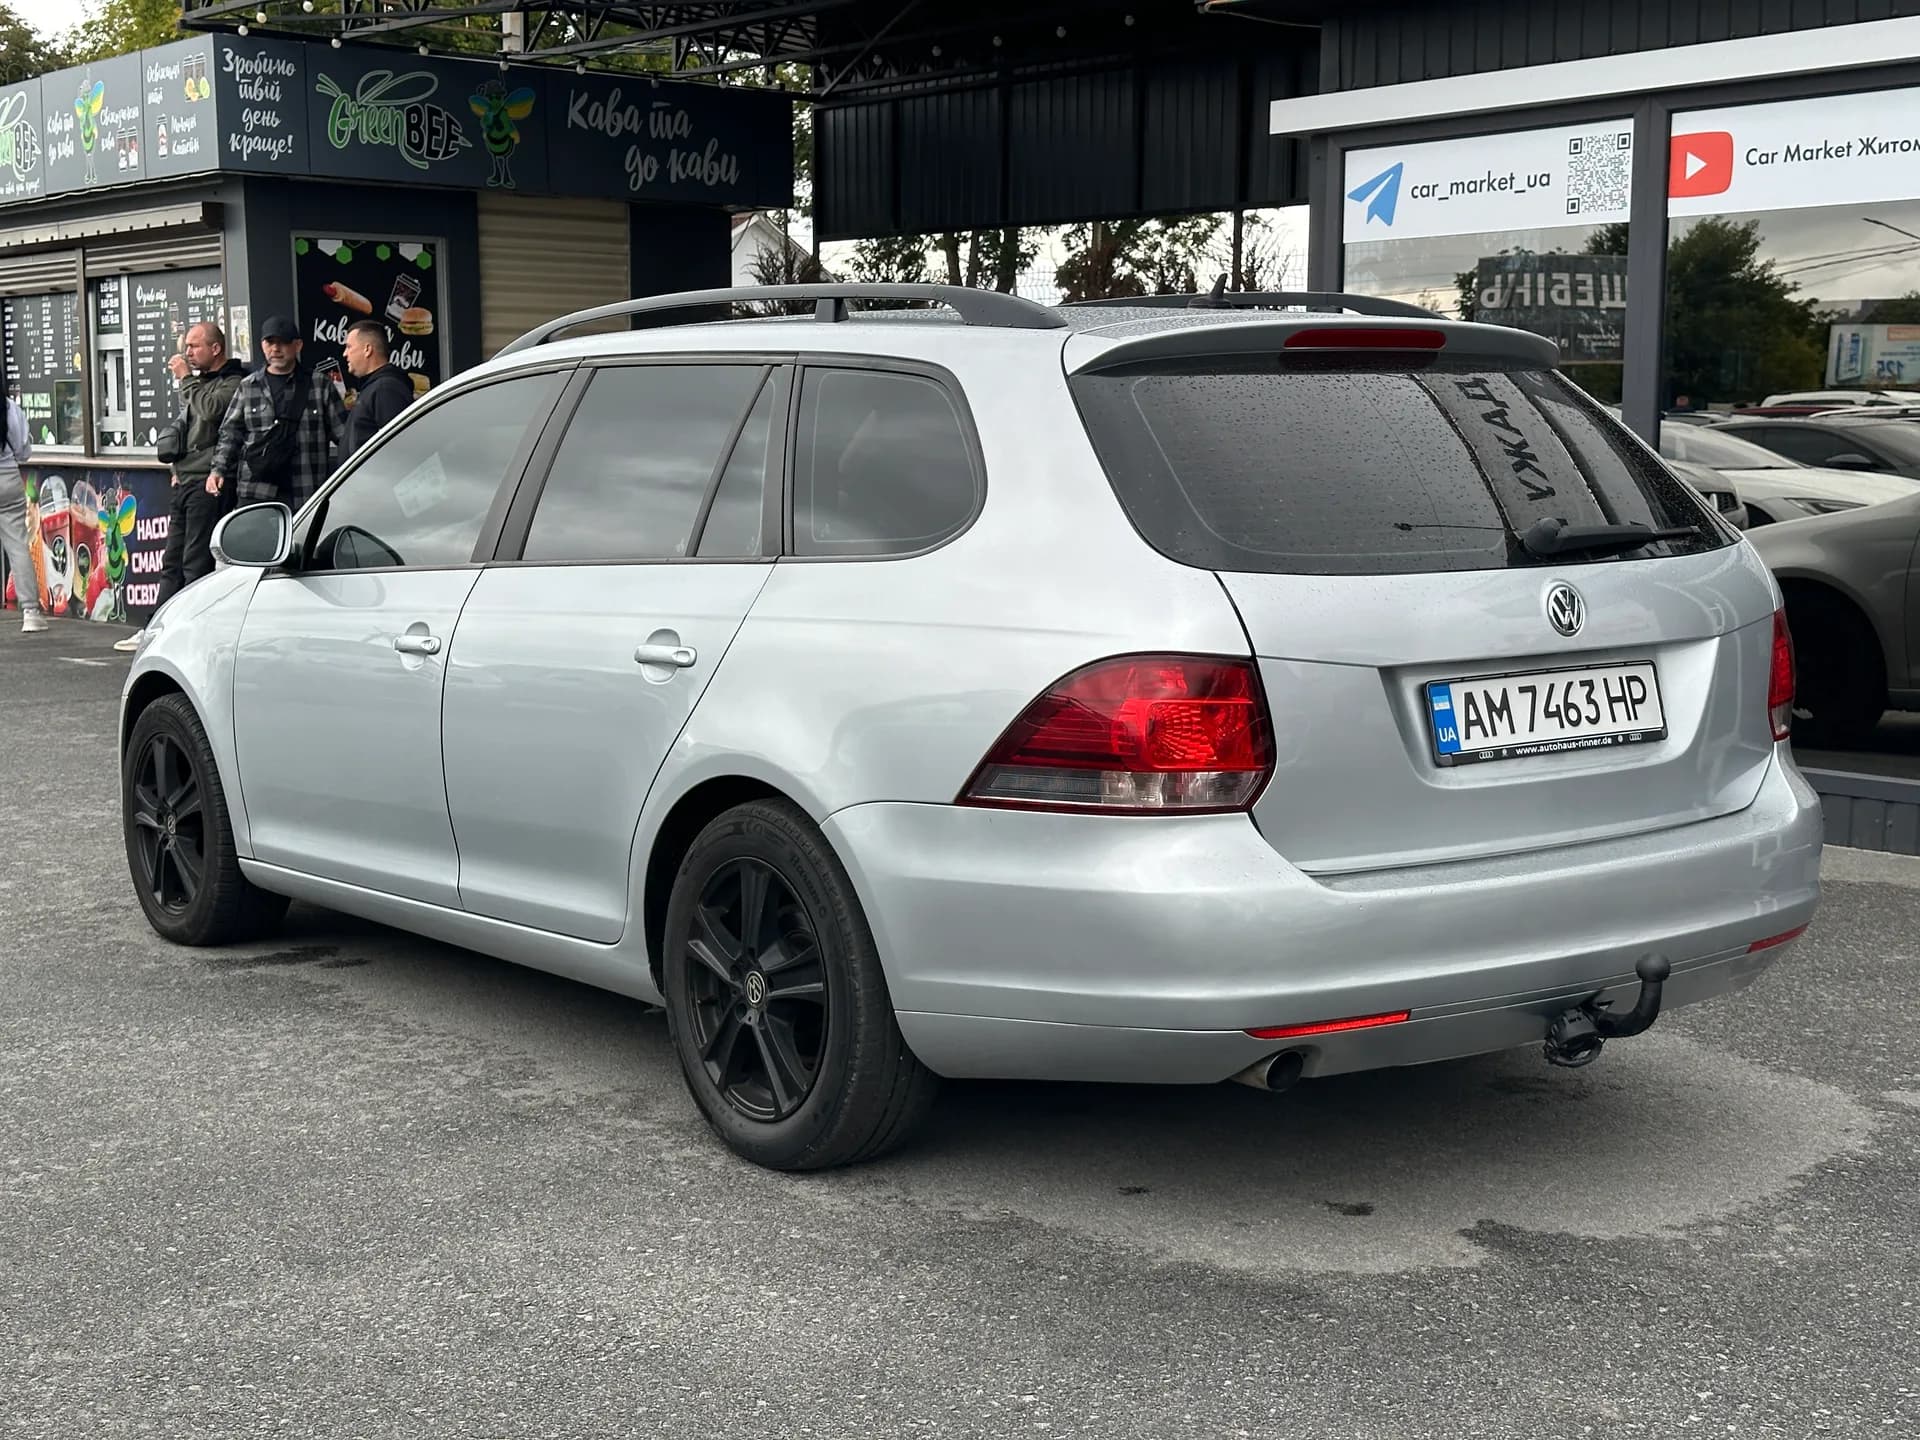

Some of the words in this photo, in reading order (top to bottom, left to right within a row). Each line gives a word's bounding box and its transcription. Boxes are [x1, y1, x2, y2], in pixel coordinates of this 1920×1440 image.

[222, 47, 296, 82] Зробимо
[239, 75, 282, 102] твій
[241, 107, 281, 133] день
[567, 87, 643, 137] Кава
[650, 101, 693, 140] та
[228, 132, 293, 162] краще!
[1745, 147, 1778, 166] Car
[1783, 139, 1852, 163] Market
[624, 144, 660, 191] до
[667, 137, 740, 186] кави
[1411, 170, 1551, 201] car_market_ua
[313, 315, 349, 345] Кав
[389, 341, 425, 370] ави
[137, 515, 171, 541] НАСО
[1464, 687, 1516, 740] AM
[1518, 679, 1600, 733] 7463
[1603, 674, 1647, 722] HP
[1438, 727, 1457, 743] UA
[1515, 736, 1612, 755] www.autohaus-rinner.de
